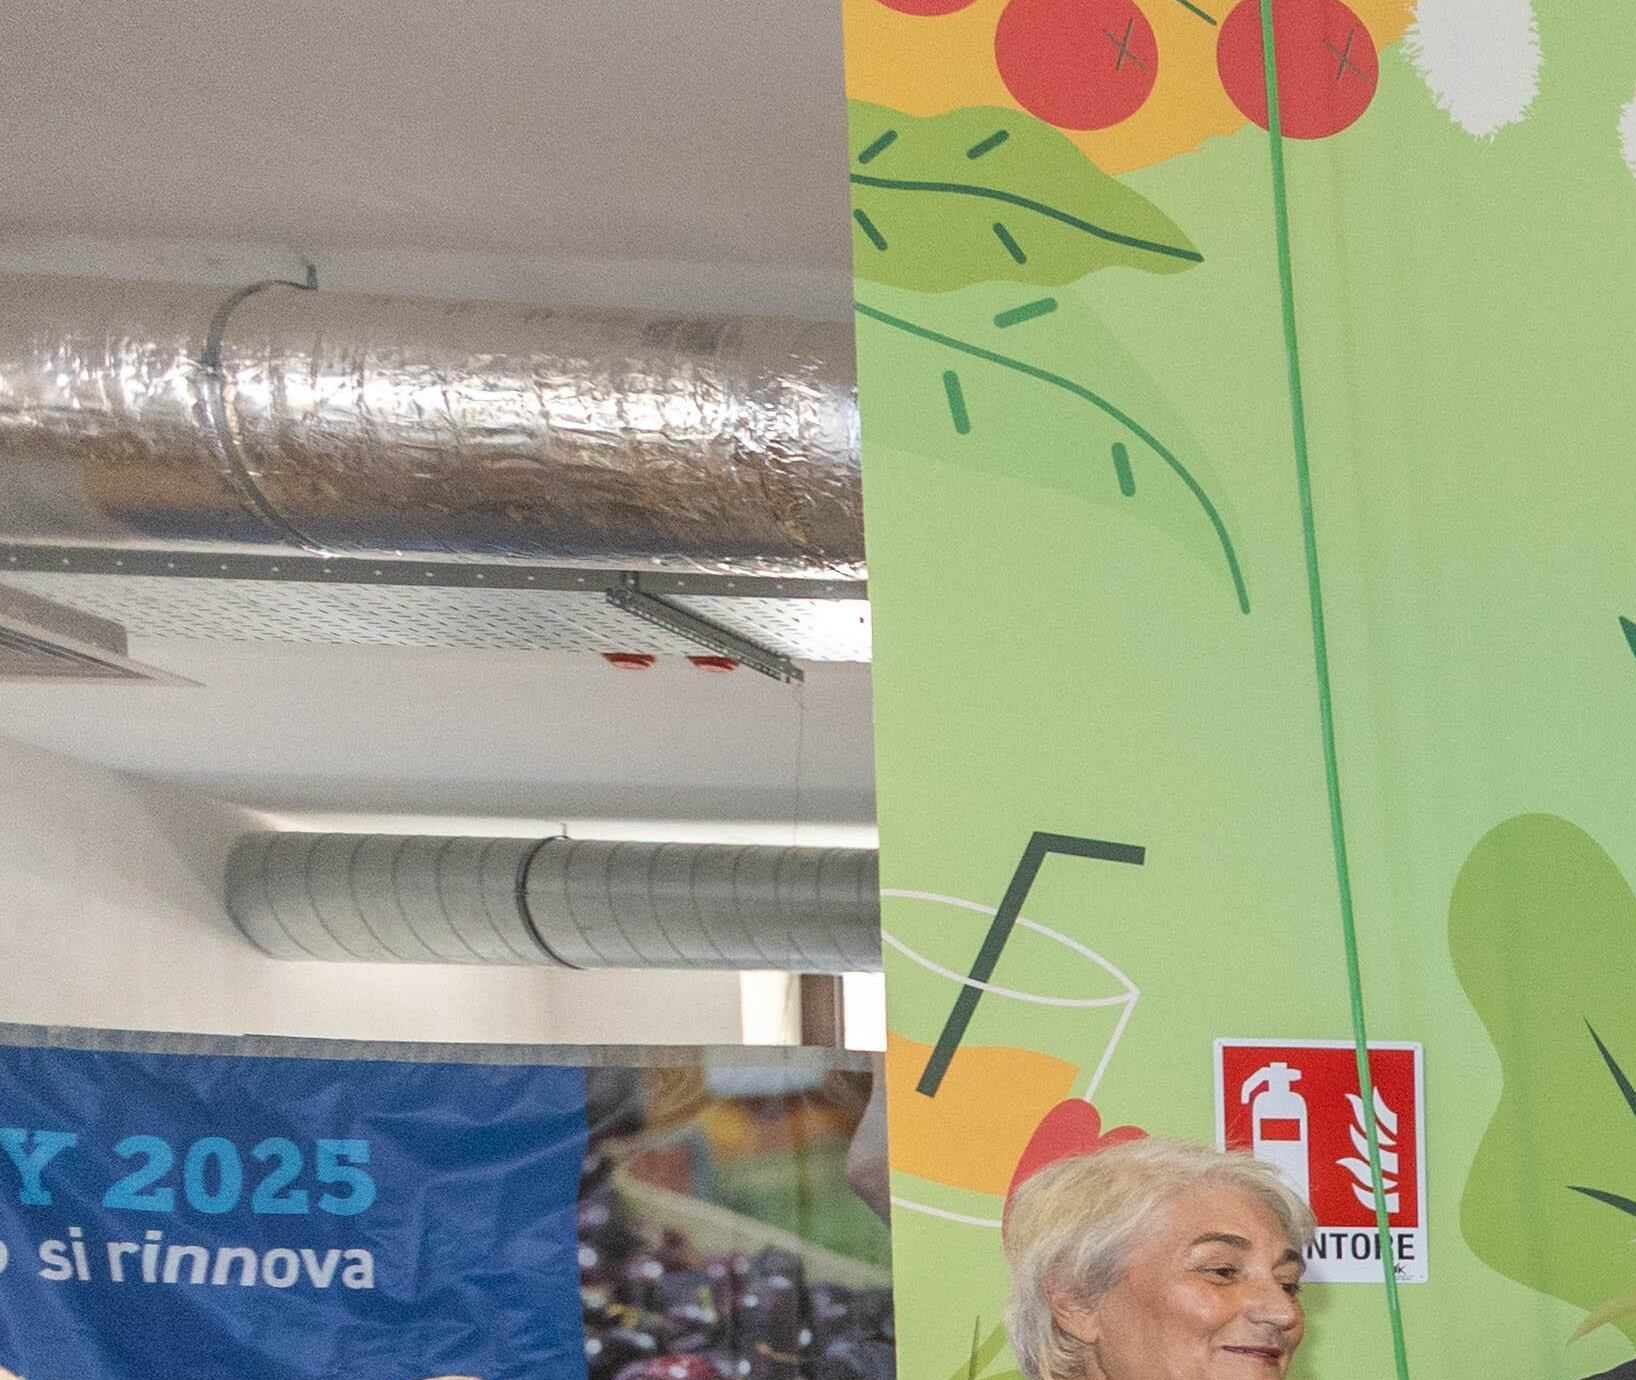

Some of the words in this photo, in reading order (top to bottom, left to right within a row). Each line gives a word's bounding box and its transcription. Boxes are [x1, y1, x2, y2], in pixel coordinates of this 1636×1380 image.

[102, 1134, 377, 1216] 2025
[38, 1226, 91, 1282] si
[106, 1229, 375, 1289] rinnova
